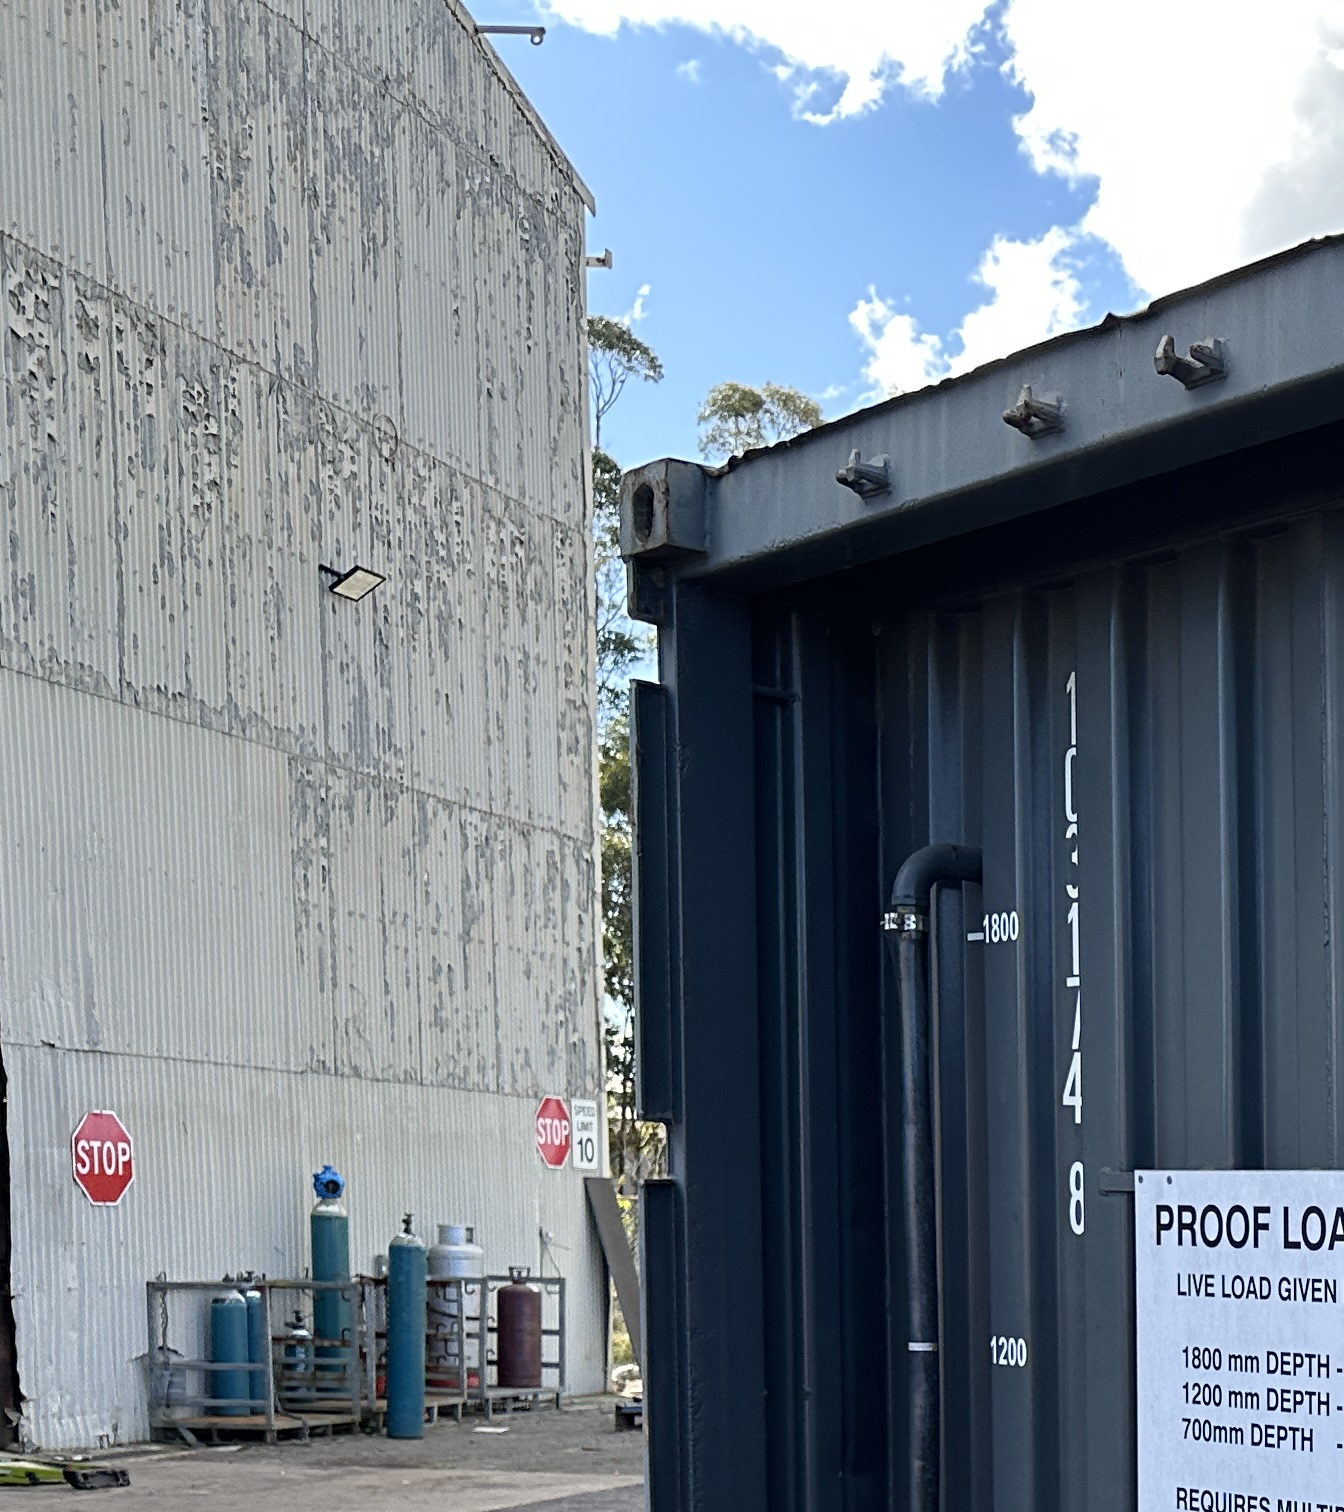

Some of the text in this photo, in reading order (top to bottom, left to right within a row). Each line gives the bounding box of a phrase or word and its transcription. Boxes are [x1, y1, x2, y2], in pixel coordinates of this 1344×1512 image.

[984, 911, 1018, 943] 1800
[537, 1118, 570, 1146] STOP
[76, 1139, 131, 1176] STOP
[577, 1137, 595, 1163] 10
[1156, 1205, 1270, 1248] PROOF
[1178, 1273, 1215, 1297] LIVE
[1222, 1275, 1271, 1299] LOAD
[1278, 1277, 1336, 1303] GIVEN
[991, 1336, 1026, 1367] 1200
[1183, 1346, 1221, 1370] 1800
[1229, 1354, 1259, 1373] mm
[1267, 1351, 1329, 1378] DEPTH
[1183, 1382, 1222, 1407] 1200
[1229, 1391, 1259, 1410] mm
[1267, 1388, 1329, 1416] DEPTH
[1182, 1418, 1243, 1445] 700mm
[1251, 1423, 1313, 1452] DEPTH
